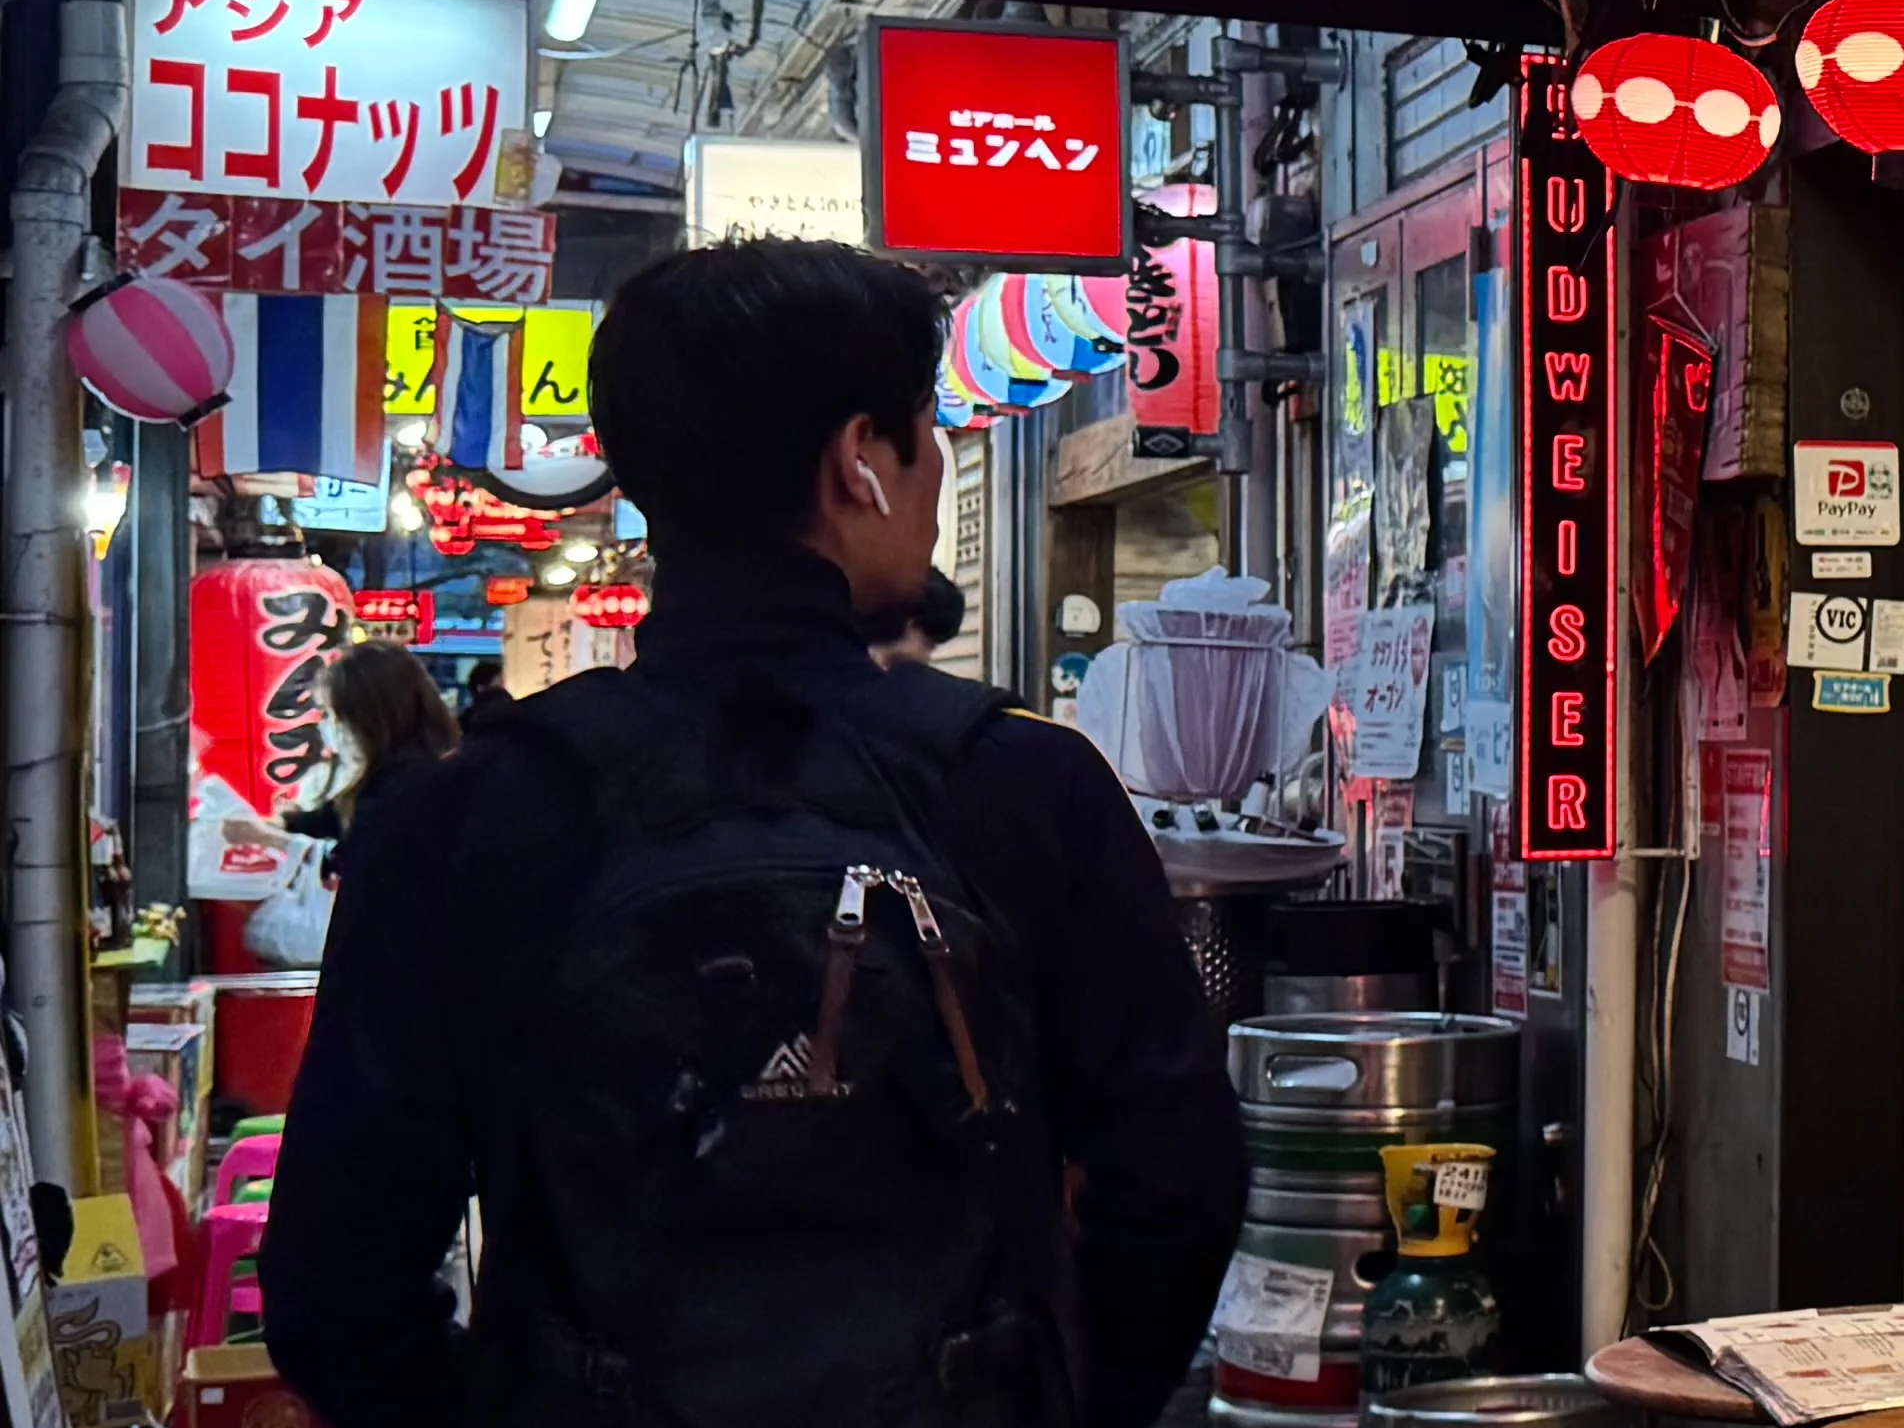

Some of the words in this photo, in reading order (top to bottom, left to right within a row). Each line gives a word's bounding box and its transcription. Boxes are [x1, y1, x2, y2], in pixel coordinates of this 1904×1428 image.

[146, 58, 500, 204] ココナッツ
[905, 130, 1100, 172] ミュンヘン
[128, 192, 553, 305] タイ酒場
[1817, 500, 1877, 520] PayPay
[1826, 608, 1856, 629] VIC
